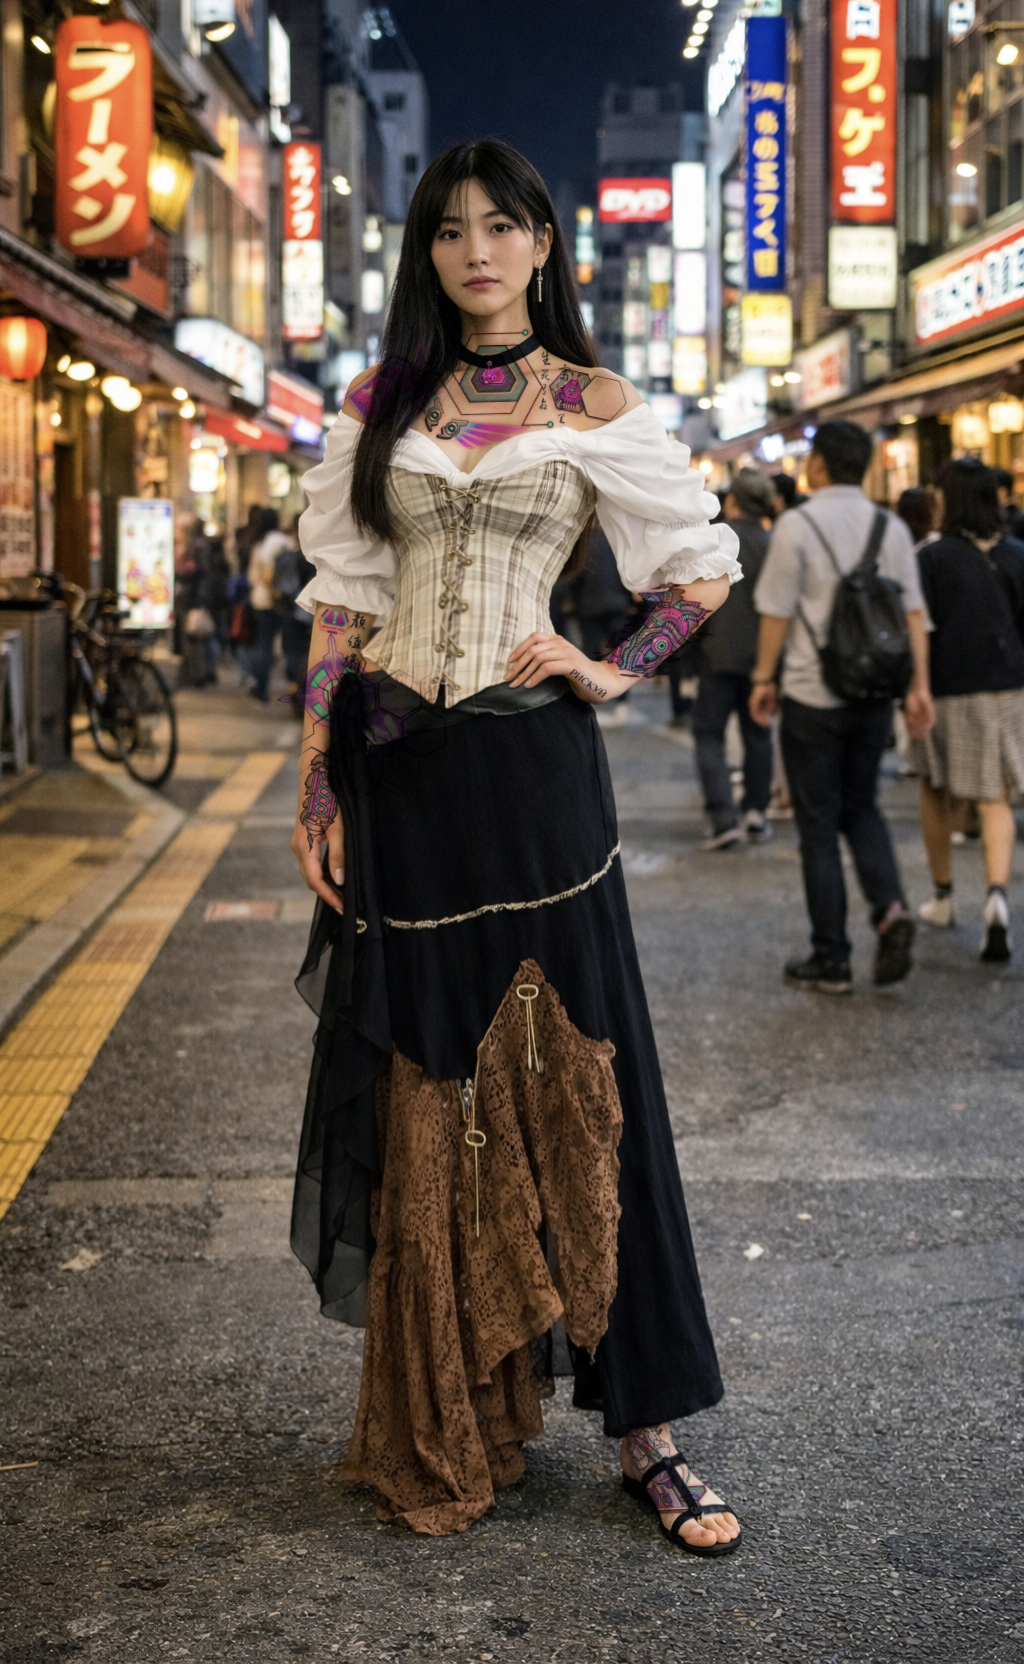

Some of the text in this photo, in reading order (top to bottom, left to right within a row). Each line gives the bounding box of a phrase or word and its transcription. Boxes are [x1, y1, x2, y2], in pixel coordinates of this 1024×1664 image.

[67, 42, 136, 246] ラーメン
[570, 668, 607, 698] РИСКУЙ
